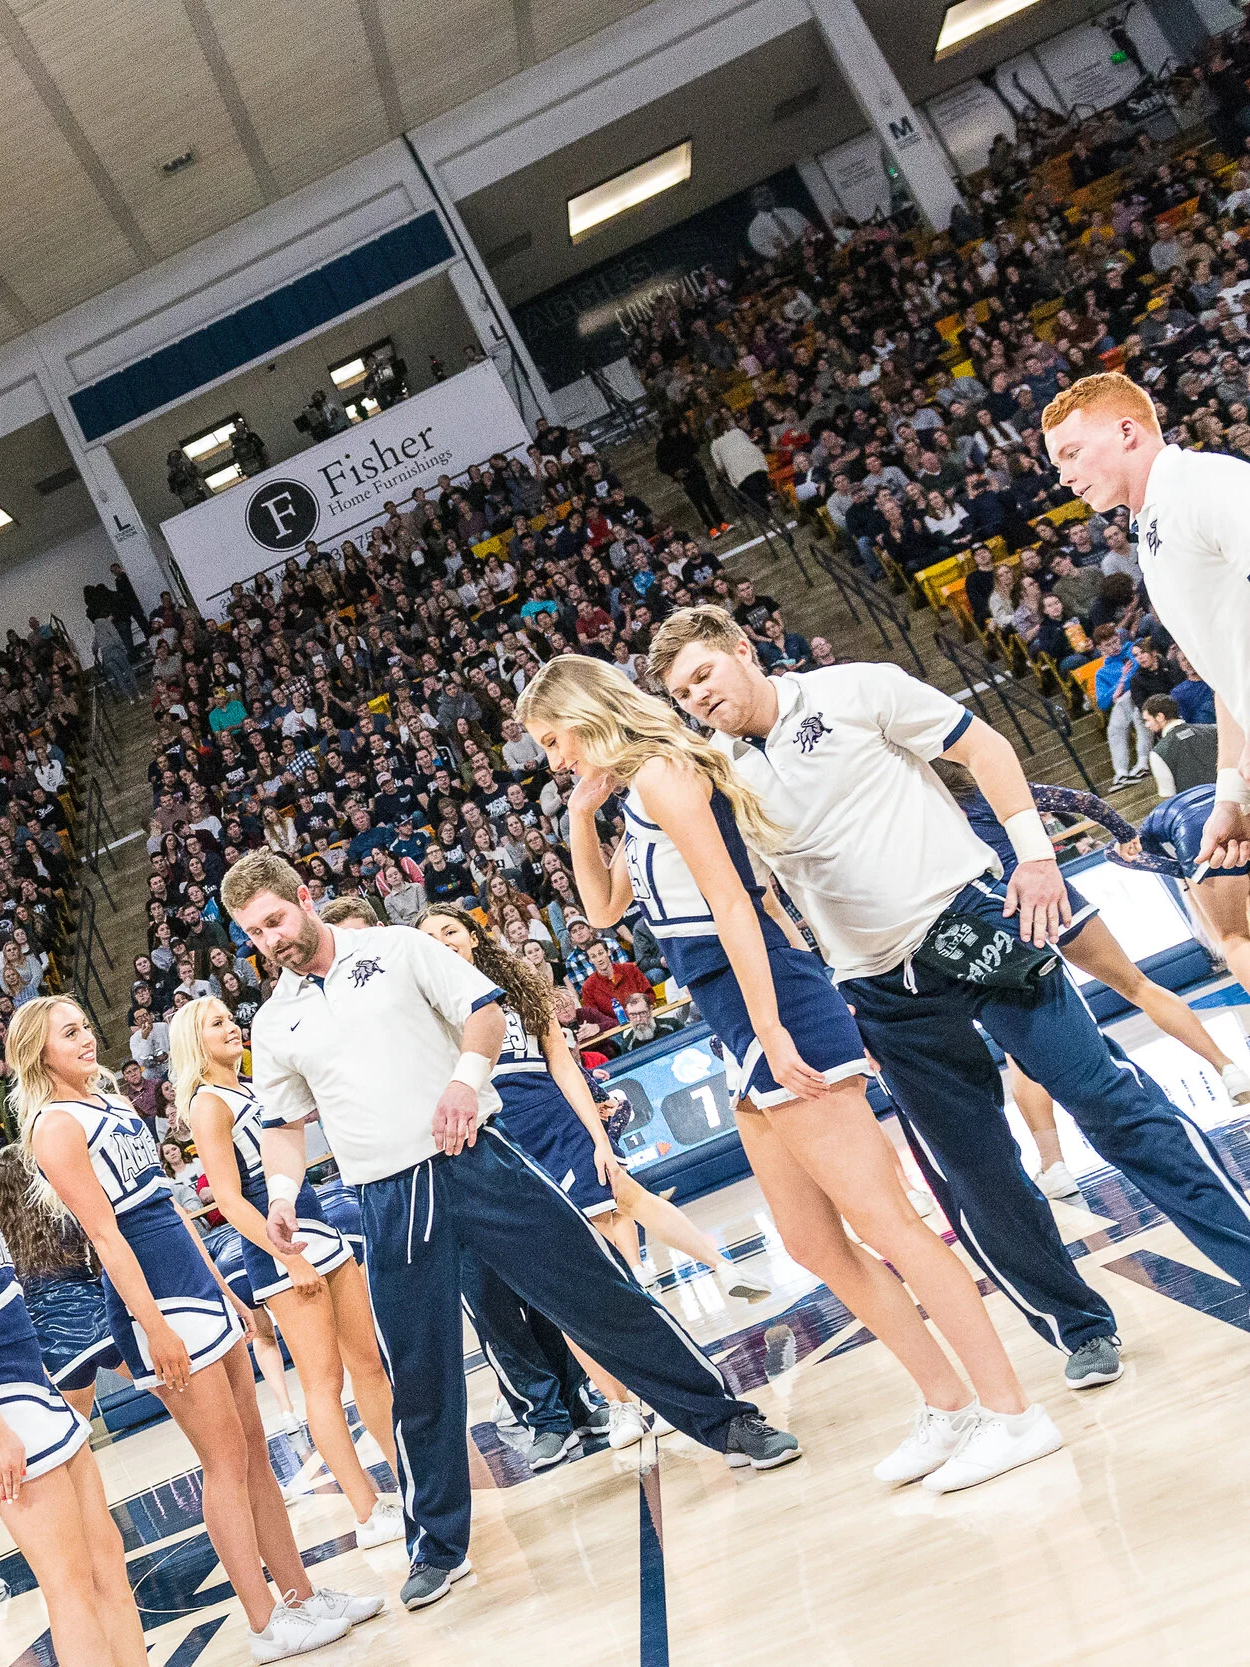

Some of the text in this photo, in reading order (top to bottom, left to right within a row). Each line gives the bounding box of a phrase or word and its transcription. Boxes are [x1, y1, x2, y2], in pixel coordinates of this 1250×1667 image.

[889, 116, 913, 140] M
[318, 427, 433, 499] Fisher
[327, 448, 453, 517] Home Furnishings
[112, 514, 131, 531] L
[261, 491, 297, 540] F
